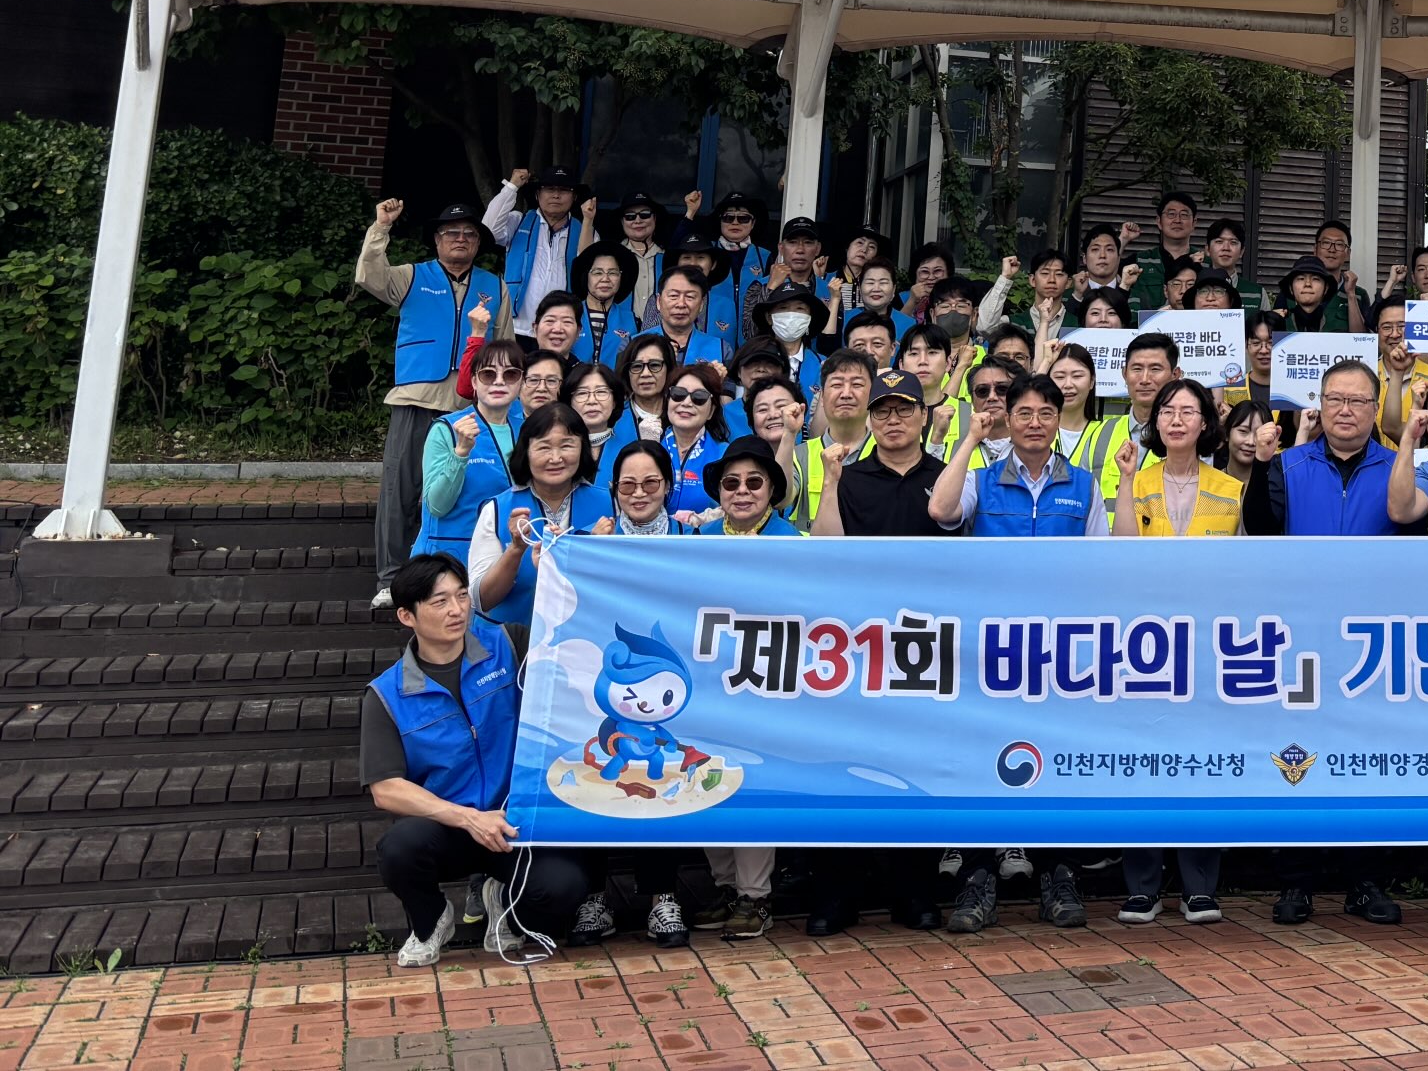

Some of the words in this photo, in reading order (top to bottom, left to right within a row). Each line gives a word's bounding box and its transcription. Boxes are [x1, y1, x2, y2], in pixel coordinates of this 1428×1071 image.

[1200, 331, 1221, 343] 바다
[1086, 346, 1109, 357] 렴한
[1183, 345, 1227, 357] 만들어요
[1286, 354, 1330, 366] 플라스틱
[1286, 367, 1319, 379] 깨끗한
[985, 621, 1189, 696] 바다의
[1053, 753, 1245, 777] 인천지방해양수산청
